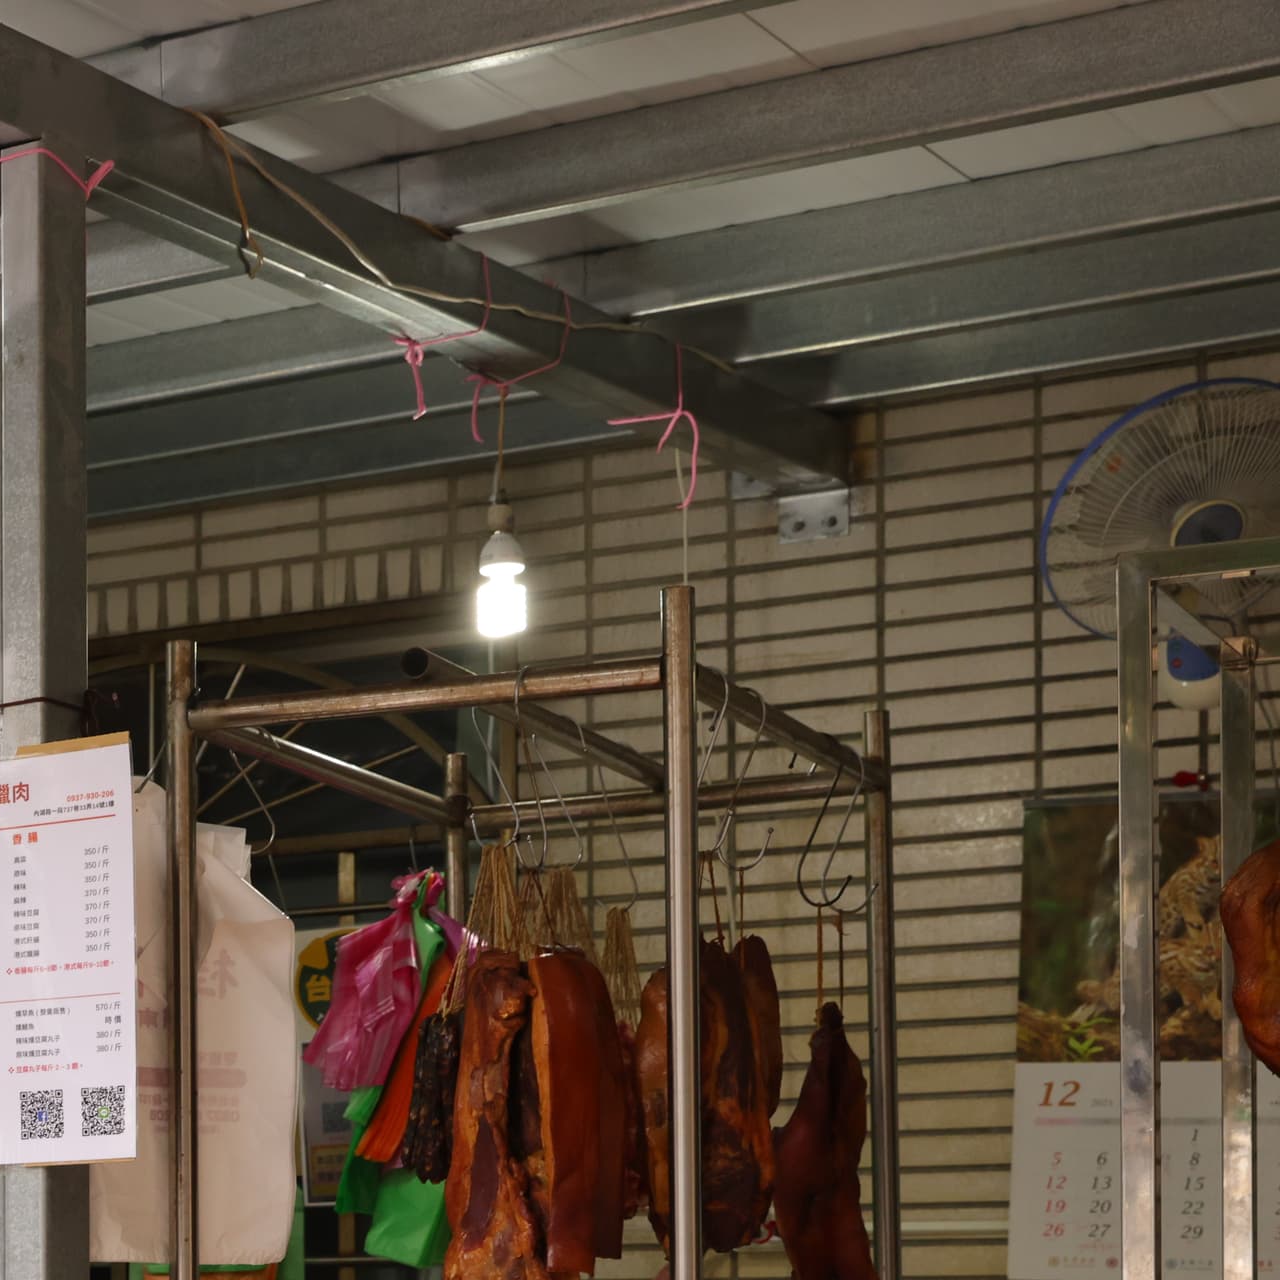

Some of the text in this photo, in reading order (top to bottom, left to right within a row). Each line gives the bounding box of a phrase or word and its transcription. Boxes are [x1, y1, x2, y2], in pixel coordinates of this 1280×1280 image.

[1038, 1080, 1081, 1107] 12
[1191, 1128, 1199, 1142] 1
[1052, 1152, 1200, 1166] 5 6 8
[1046, 1176, 1206, 1191] 12 13 15
[1045, 1200, 1205, 1215] 19 20 22
[1043, 1223, 1203, 1239] 26 27 29
